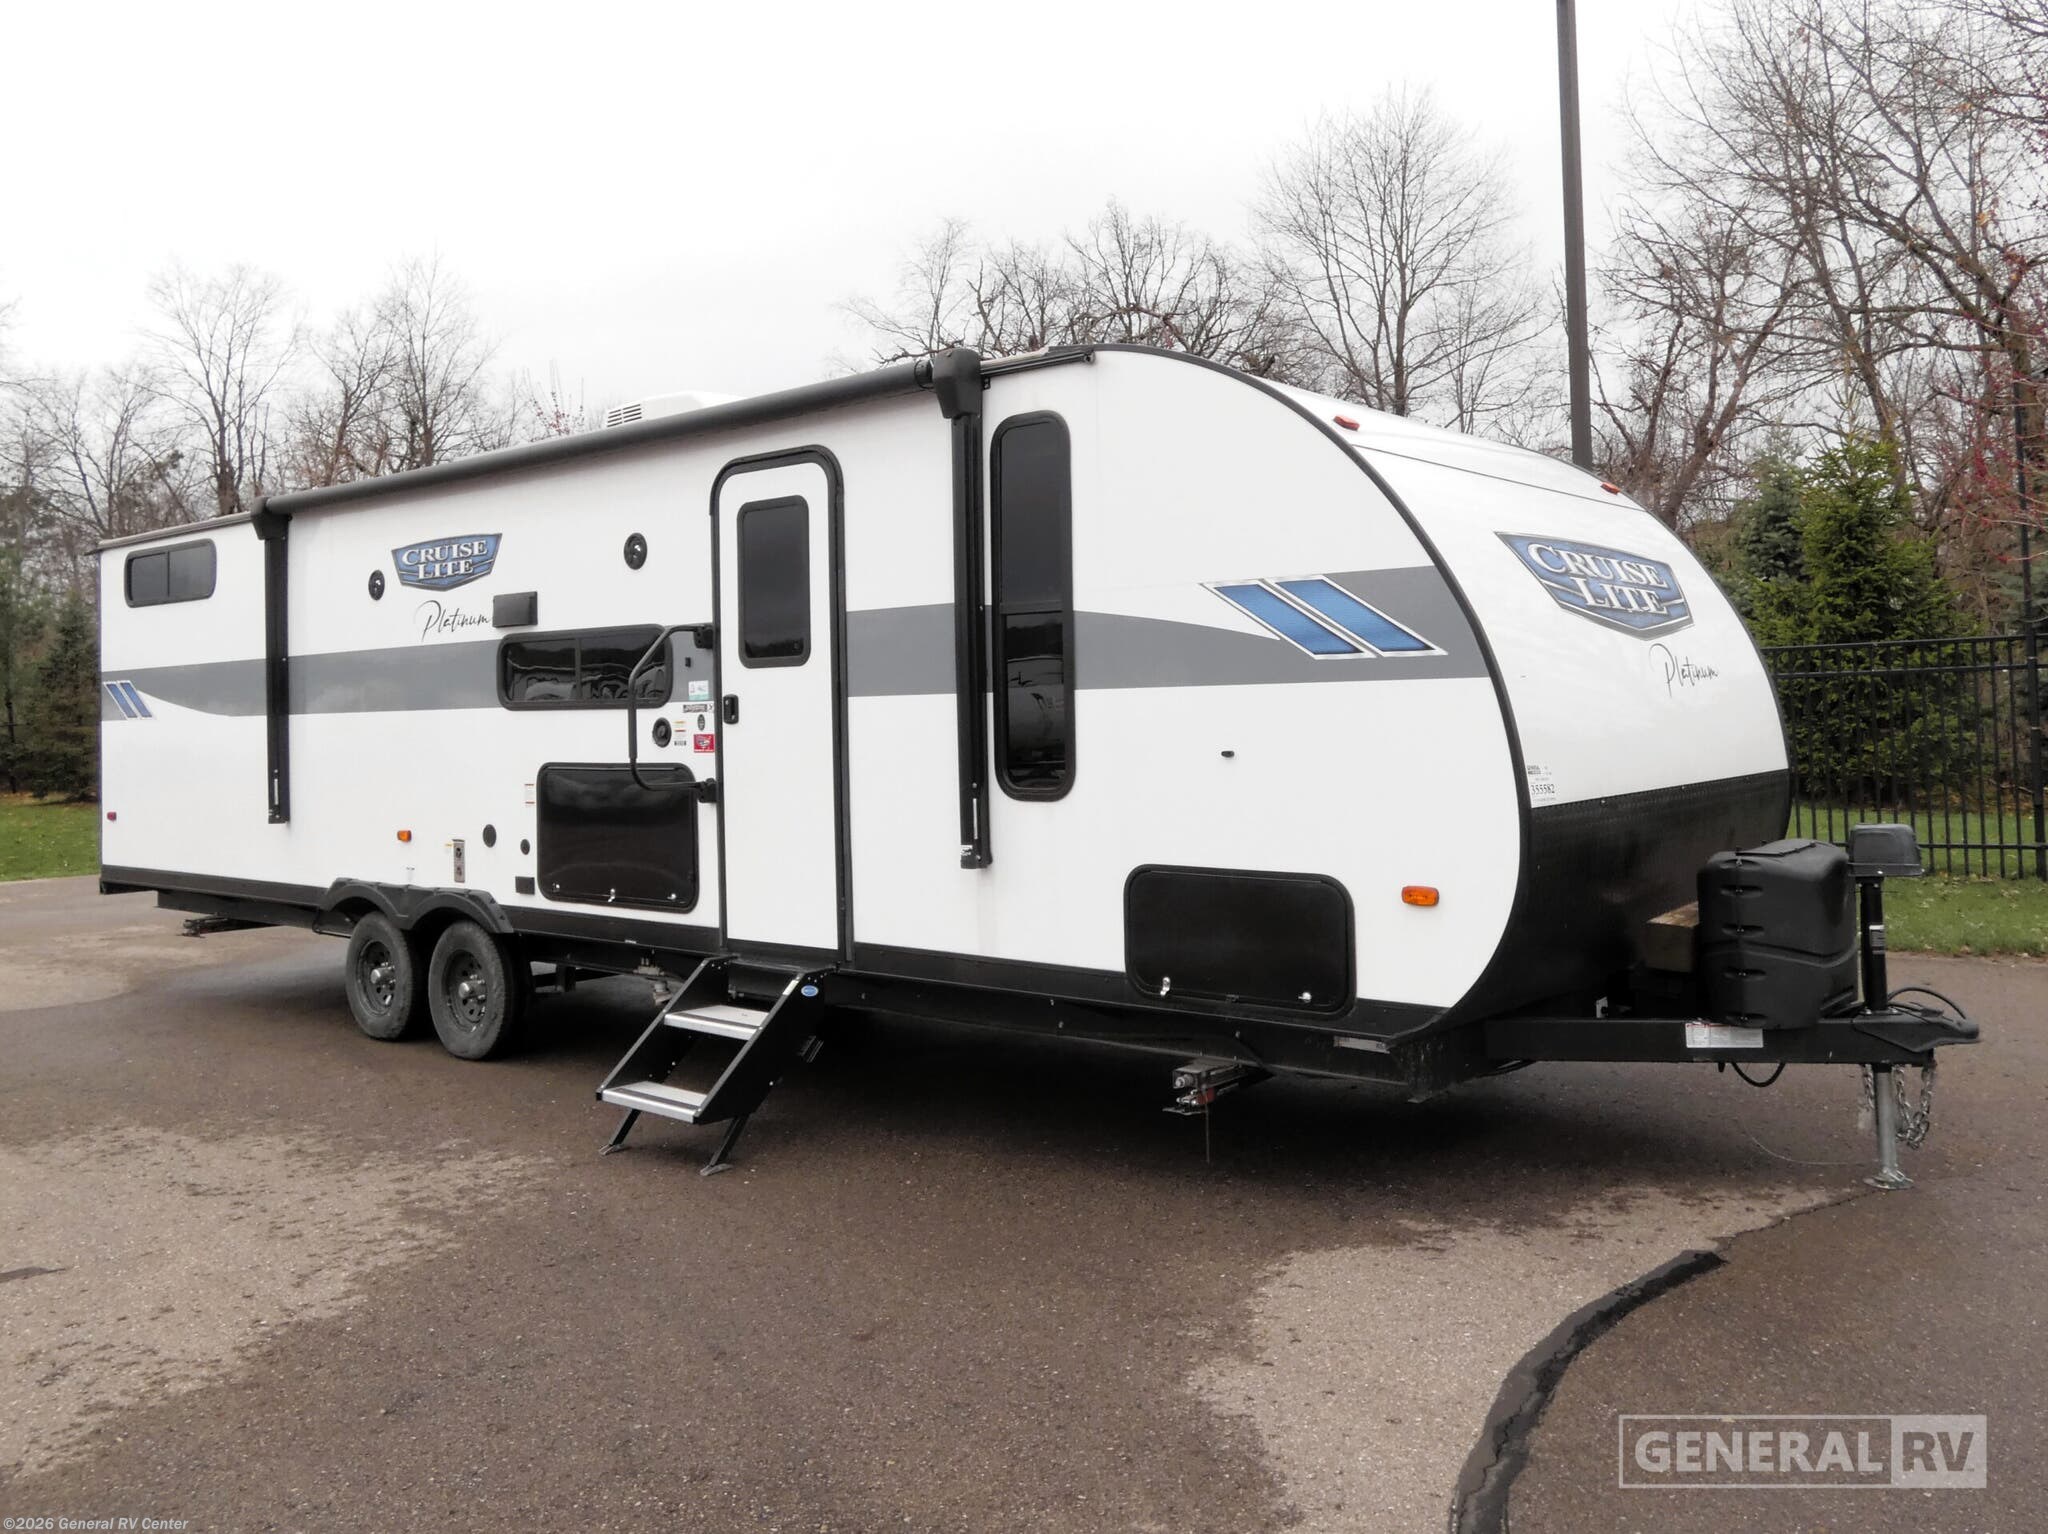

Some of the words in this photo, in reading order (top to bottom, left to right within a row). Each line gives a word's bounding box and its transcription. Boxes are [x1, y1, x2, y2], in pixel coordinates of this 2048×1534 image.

[402, 540, 488, 566] CRUISE
[418, 559, 474, 580] LITE
[1527, 542, 1668, 589] CRUISE
[1570, 576, 1669, 615] LITE
[416, 600, 490, 642] Platinum
[1648, 643, 1719, 698] Platinum
